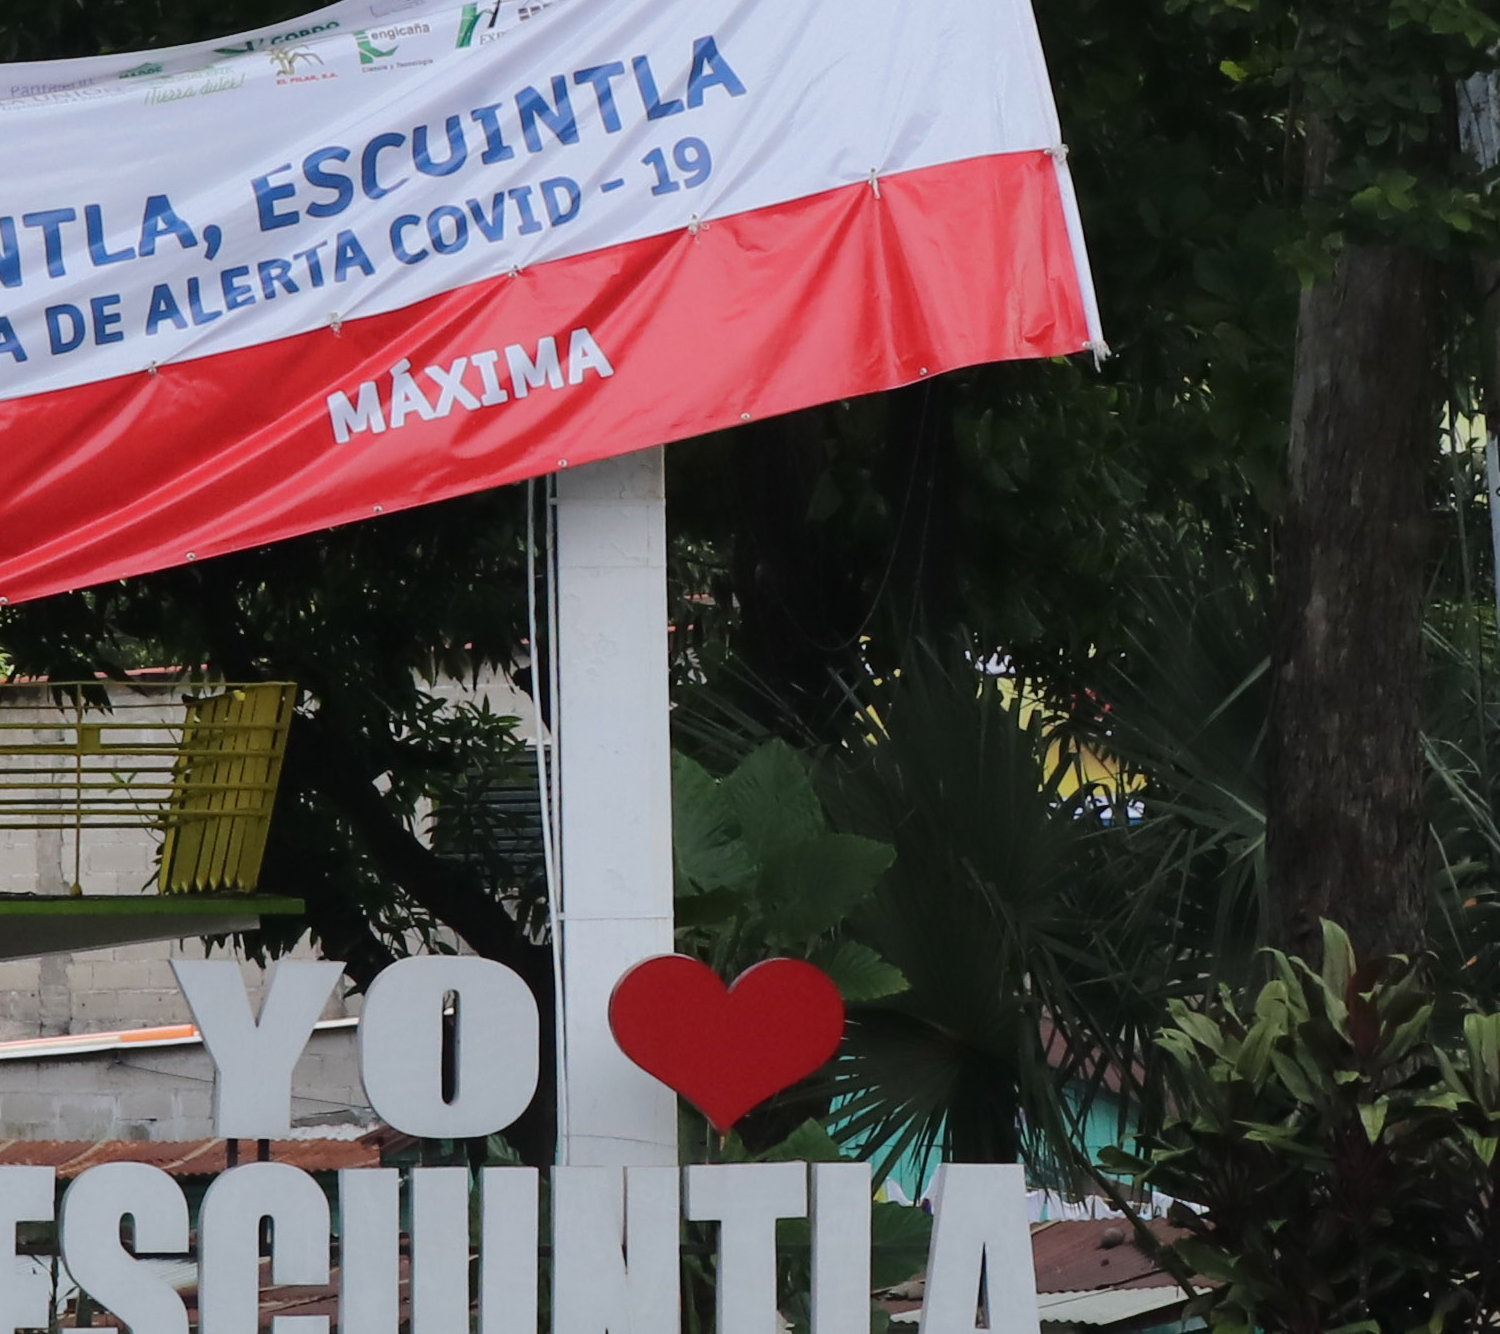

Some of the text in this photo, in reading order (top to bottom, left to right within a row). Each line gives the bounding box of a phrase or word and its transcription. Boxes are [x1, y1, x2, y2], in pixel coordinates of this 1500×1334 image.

[371, 23, 431, 44] engicaña
[250, 34, 747, 234] ESCUINTLA
[45, 292, 124, 357] DE
[146, 229, 375, 338] ALERTA
[389, 174, 582, 265] COVID
[642, 135, 714, 197] 19
[326, 328, 615, 445] MÁXIMA
